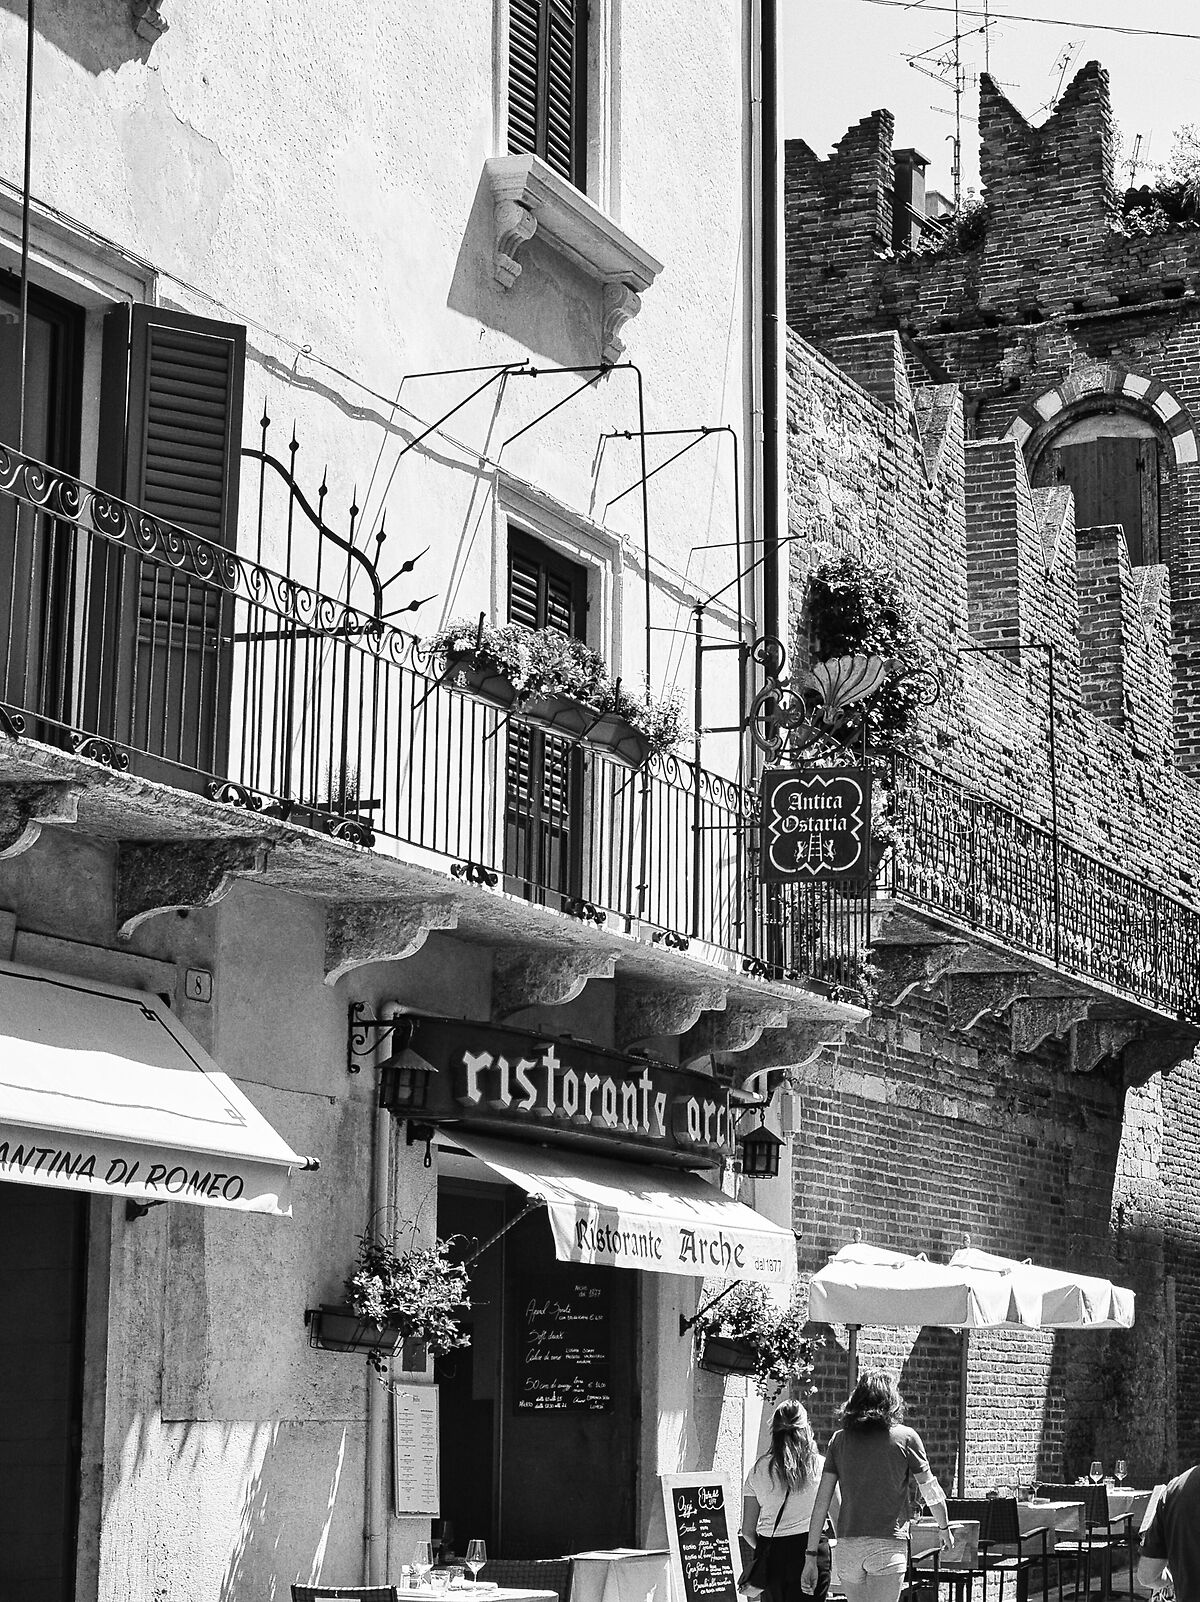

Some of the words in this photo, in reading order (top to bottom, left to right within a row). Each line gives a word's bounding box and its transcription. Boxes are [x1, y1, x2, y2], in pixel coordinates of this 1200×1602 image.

[787, 792, 843, 811] Antica
[781, 814, 847, 833] Ostaria
[195, 975, 202, 995] 8
[462, 1043, 667, 1137] ristorante
[105, 1158, 140, 1187] DI
[145, 1164, 244, 1201] ROMEO
[575, 1217, 662, 1260] Ristorante
[678, 1228, 746, 1272] Arche
